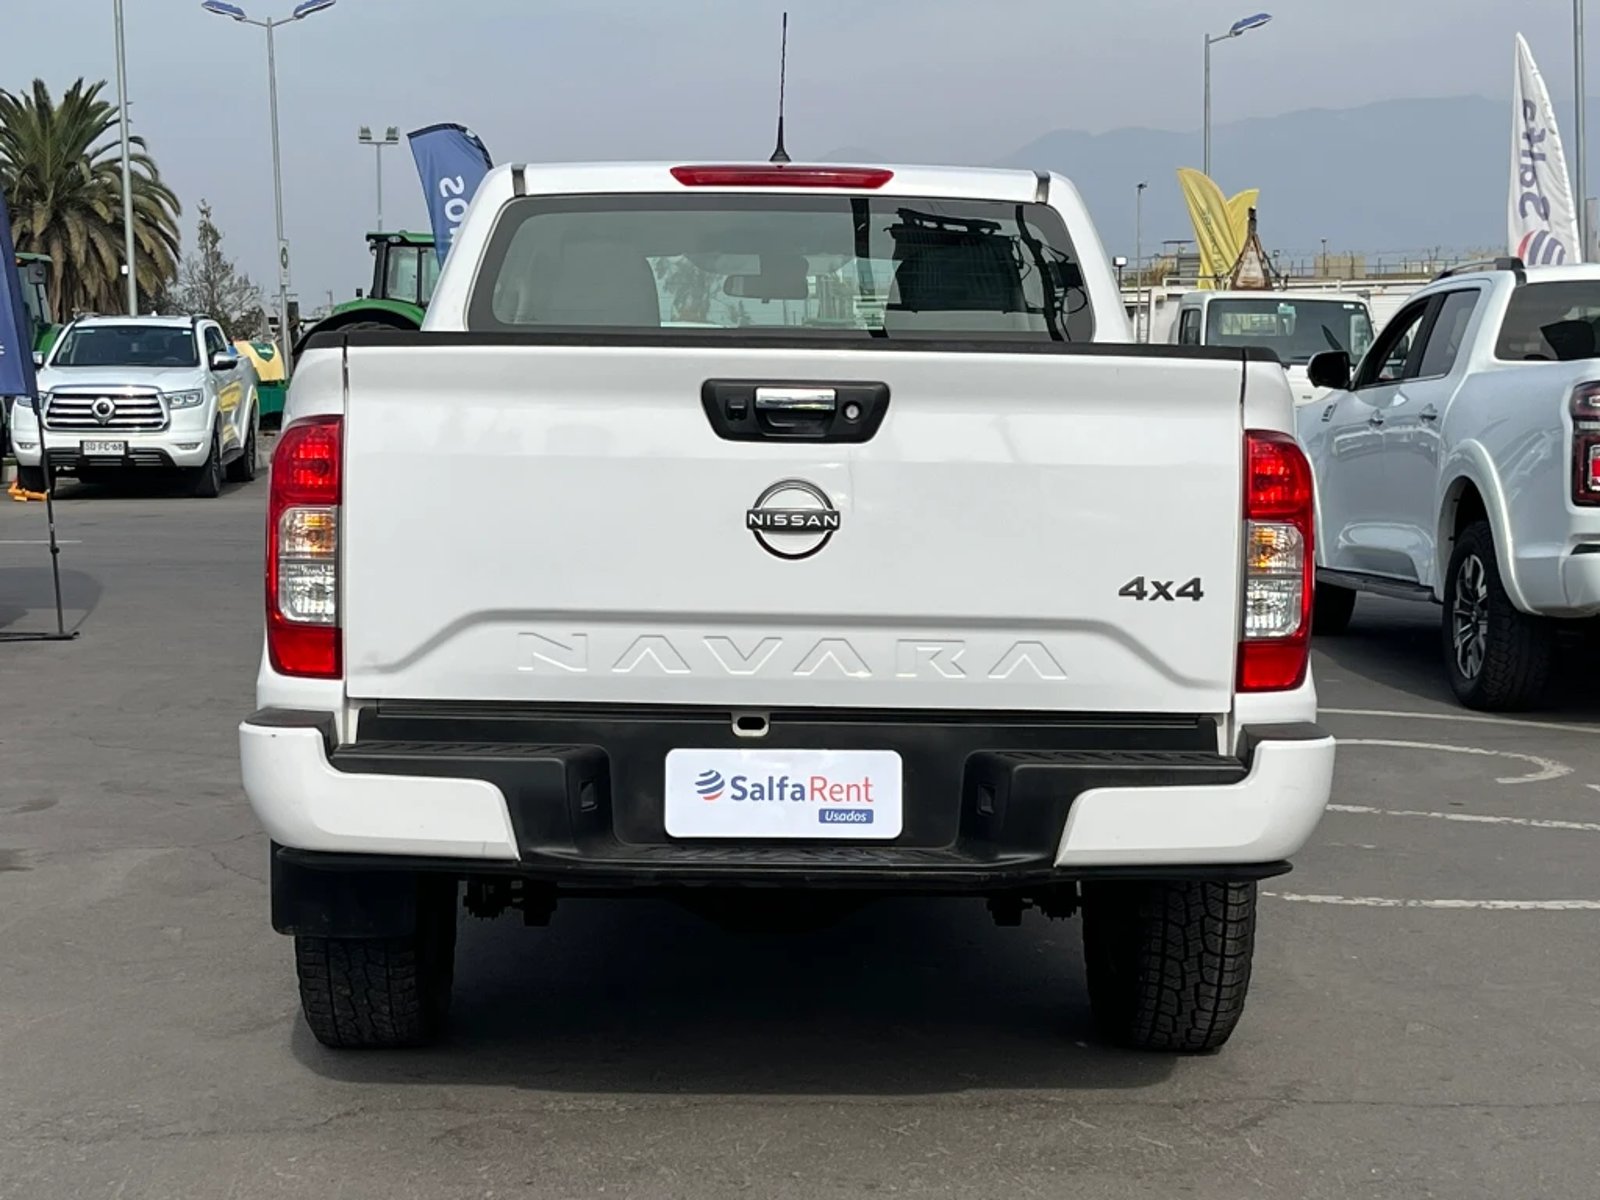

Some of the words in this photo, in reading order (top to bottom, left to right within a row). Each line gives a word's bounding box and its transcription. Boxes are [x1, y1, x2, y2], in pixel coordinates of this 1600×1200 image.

[748, 513, 838, 527] NISSAN
[1118, 576, 1204, 602] 4x4
[517, 632, 1067, 680] NAVARA
[730, 775, 874, 802] SalfaRent
[824, 810, 867, 823] Usados
